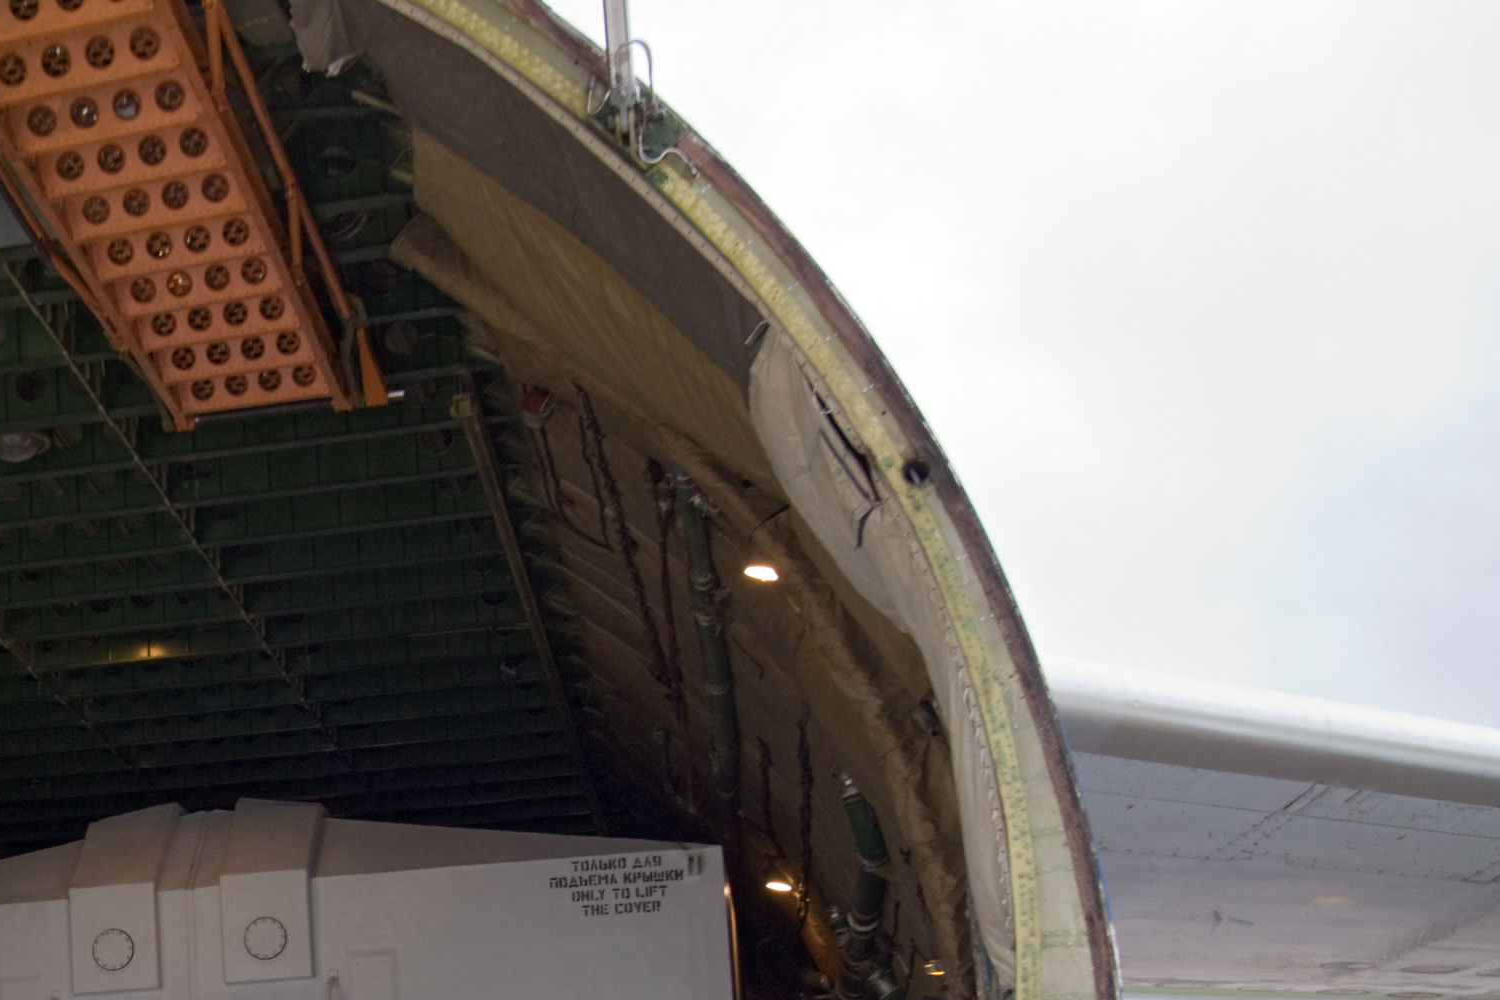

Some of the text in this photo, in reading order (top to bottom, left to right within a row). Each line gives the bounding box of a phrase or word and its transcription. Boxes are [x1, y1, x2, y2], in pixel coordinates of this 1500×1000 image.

[572, 856, 662, 872] ТОЛЬКО ДЛЯ
[624, 869, 683, 883] КРЫШКИ
[572, 886, 667, 902] ONLY TO LIFT
[582, 901, 661, 916] THE COVER
